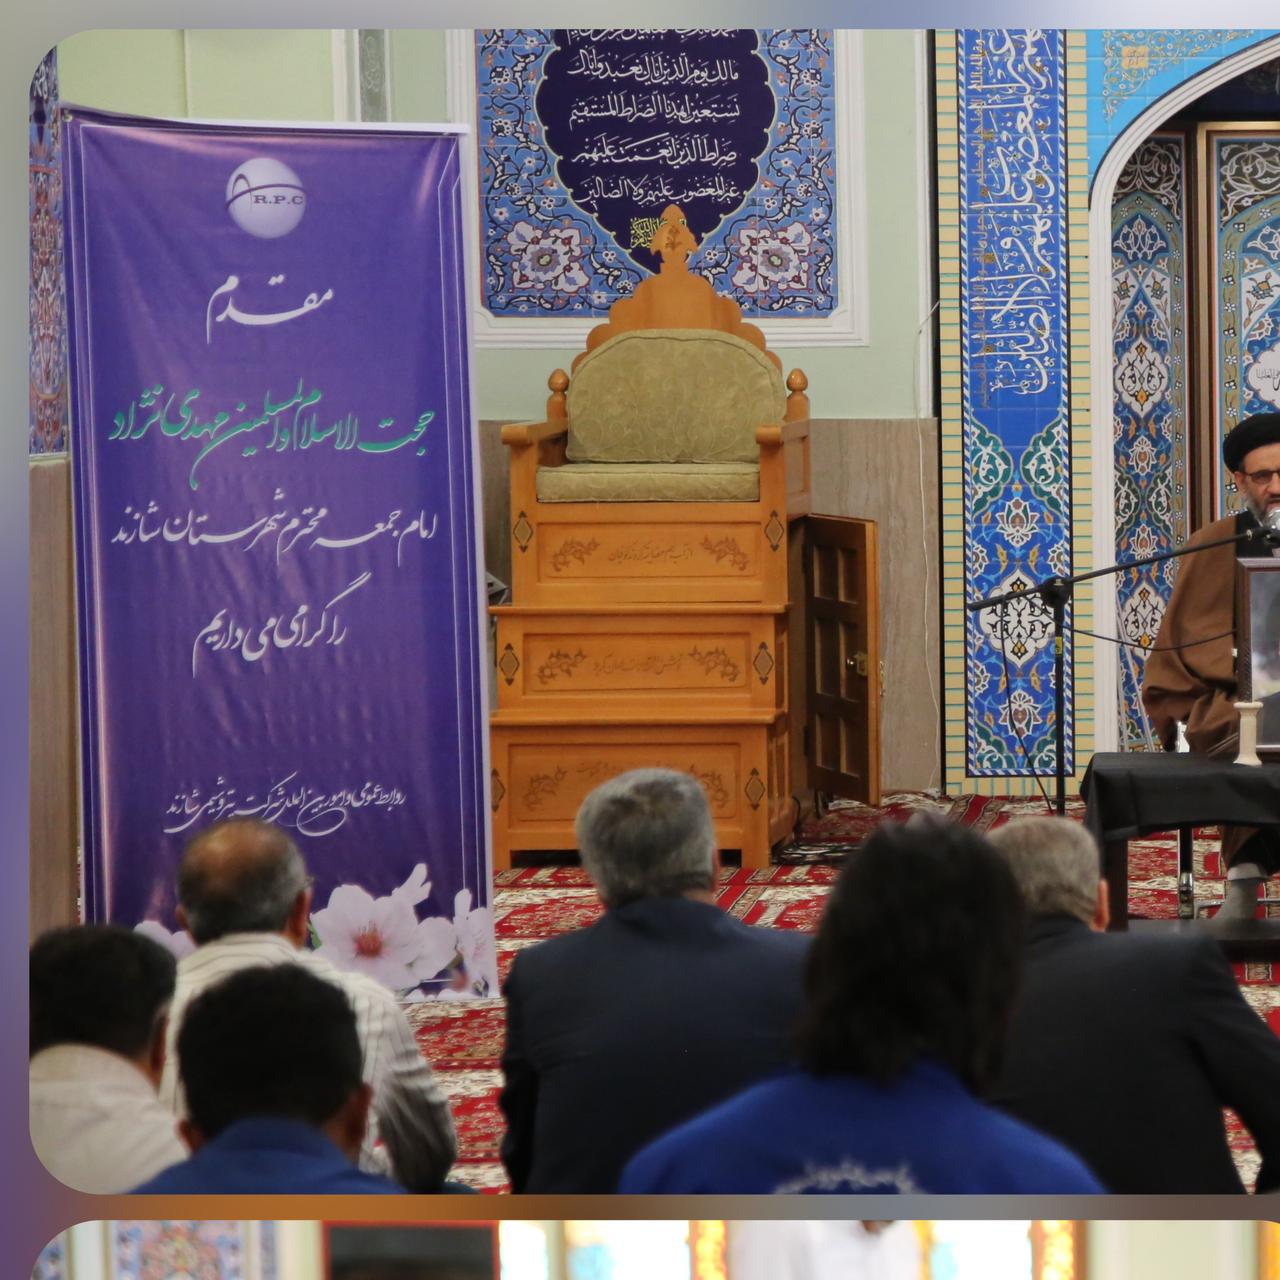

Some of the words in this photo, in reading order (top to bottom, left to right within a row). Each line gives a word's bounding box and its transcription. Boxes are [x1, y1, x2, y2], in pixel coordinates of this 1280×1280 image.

[206, 274, 333, 345] مقدم
[108, 384, 164, 440] نژاد
[358, 410, 436, 456] حجت
[111, 500, 161, 544] شازند
[162, 488, 288, 552] شهرستان
[276, 507, 329, 566] محترم
[310, 509, 402, 549] جمعه
[398, 509, 438, 568] امام
[272, 571, 372, 649] گرامی
[326, 615, 347, 645] را
[192, 609, 243, 679] داریم
